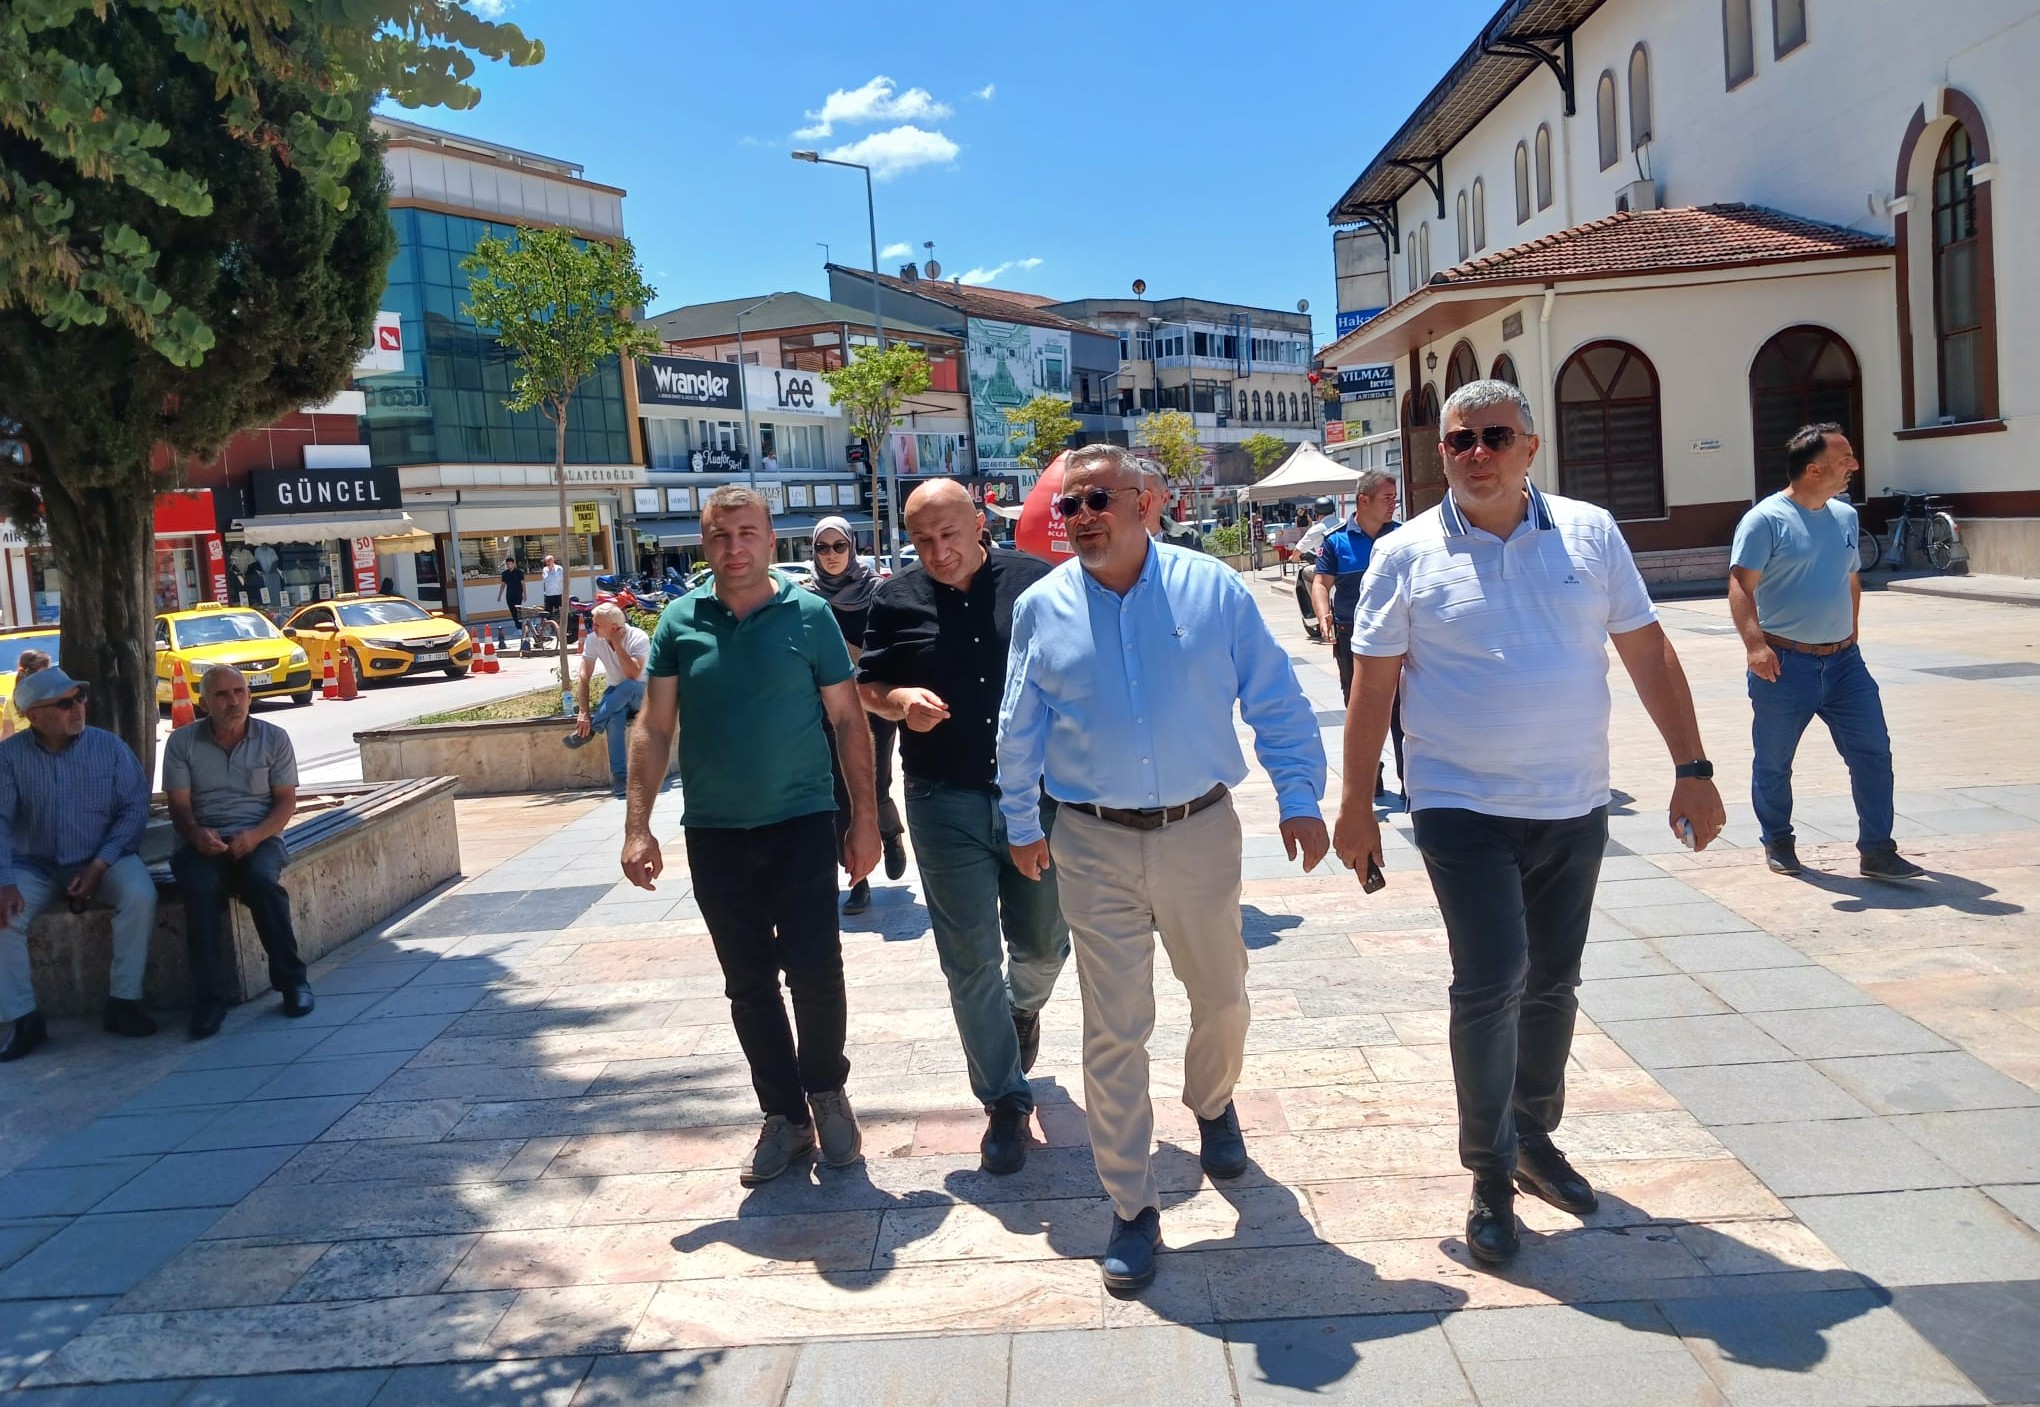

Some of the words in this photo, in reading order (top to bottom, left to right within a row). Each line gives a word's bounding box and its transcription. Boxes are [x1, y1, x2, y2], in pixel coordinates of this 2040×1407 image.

[652, 365, 729, 402] Wrangler
[1342, 368, 1389, 382] YILMAZ
[775, 371, 814, 408] Lee
[278, 478, 381, 504] GÜNCEL
[356, 537, 370, 550] 50
